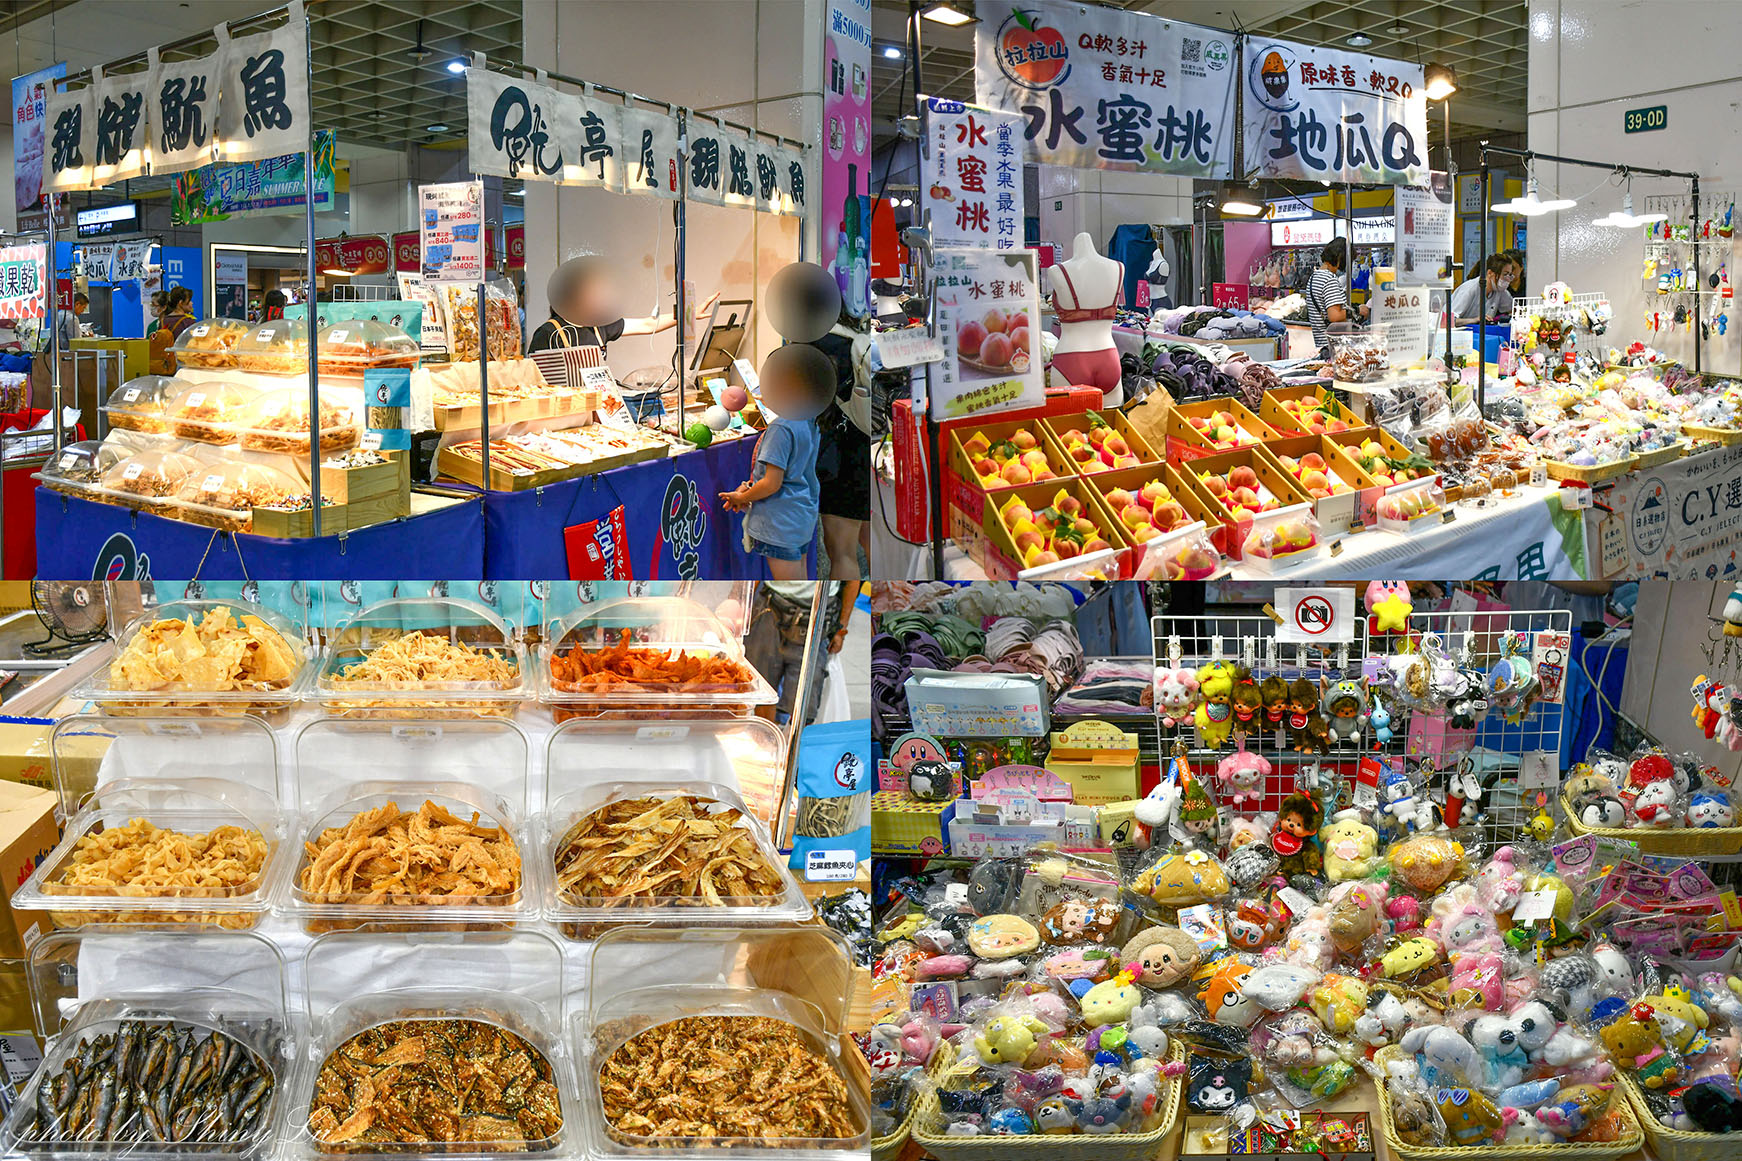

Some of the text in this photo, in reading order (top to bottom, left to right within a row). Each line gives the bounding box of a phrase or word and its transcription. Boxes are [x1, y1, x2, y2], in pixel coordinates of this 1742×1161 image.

[833, 8, 871, 48] 滿5000元
[1004, 40, 1069, 66] 拉拉山
[1078, 33, 1148, 58] Q軟多汁
[1101, 64, 1167, 89] 香氣十足
[17, 101, 46, 124] 角色快
[1020, 89, 1212, 164] 水蜜桃
[1269, 108, 1422, 171] 地瓜Q
[956, 115, 990, 233] 水蜜桃
[996, 122, 1016, 249] 當季水果最好吃
[263, 180, 300, 196] SUMMER
[968, 280, 1026, 300] 水蜜桃
[1385, 295, 1420, 309] 地瓜Q
[809, 861, 854, 870] 芝麻鱈魚夾心
